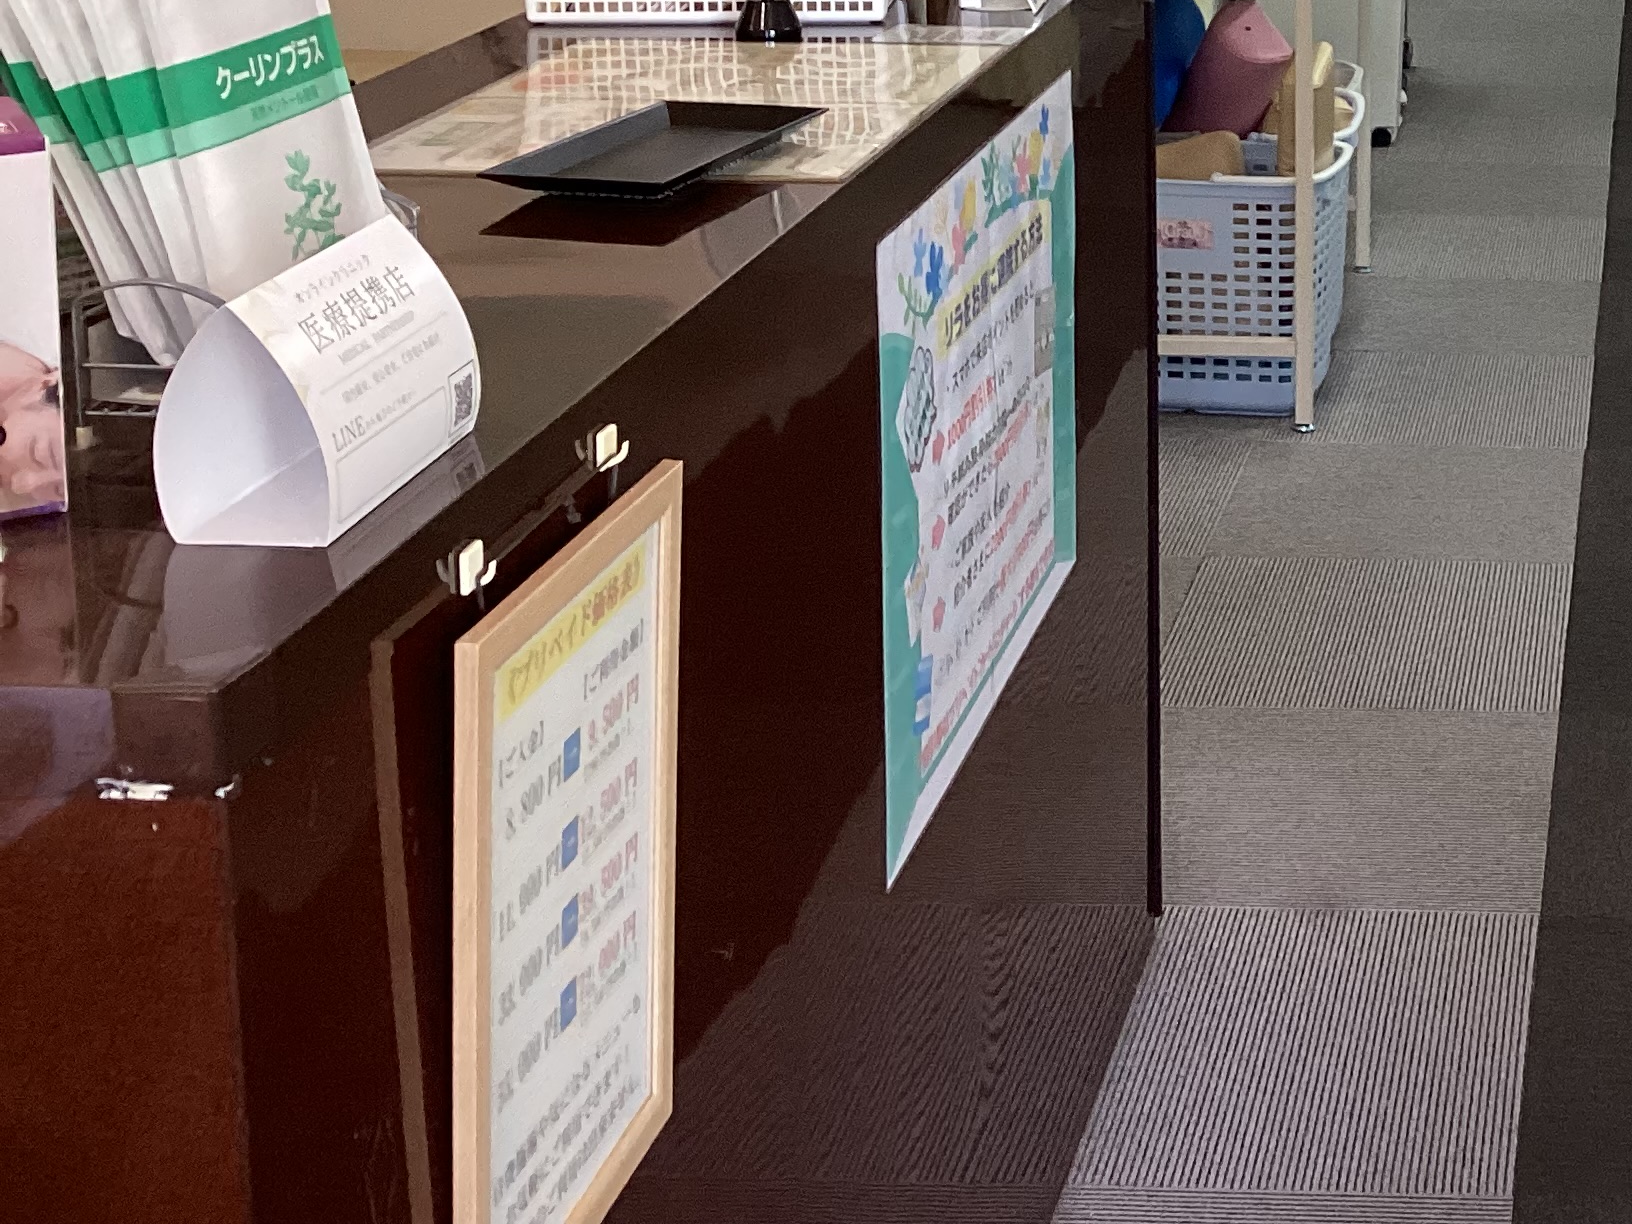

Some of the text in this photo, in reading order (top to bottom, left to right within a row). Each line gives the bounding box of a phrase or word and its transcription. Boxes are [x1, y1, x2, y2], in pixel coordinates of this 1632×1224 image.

[216, 34, 325, 100] クーリンプラス
[297, 264, 416, 355] 医療提携店
